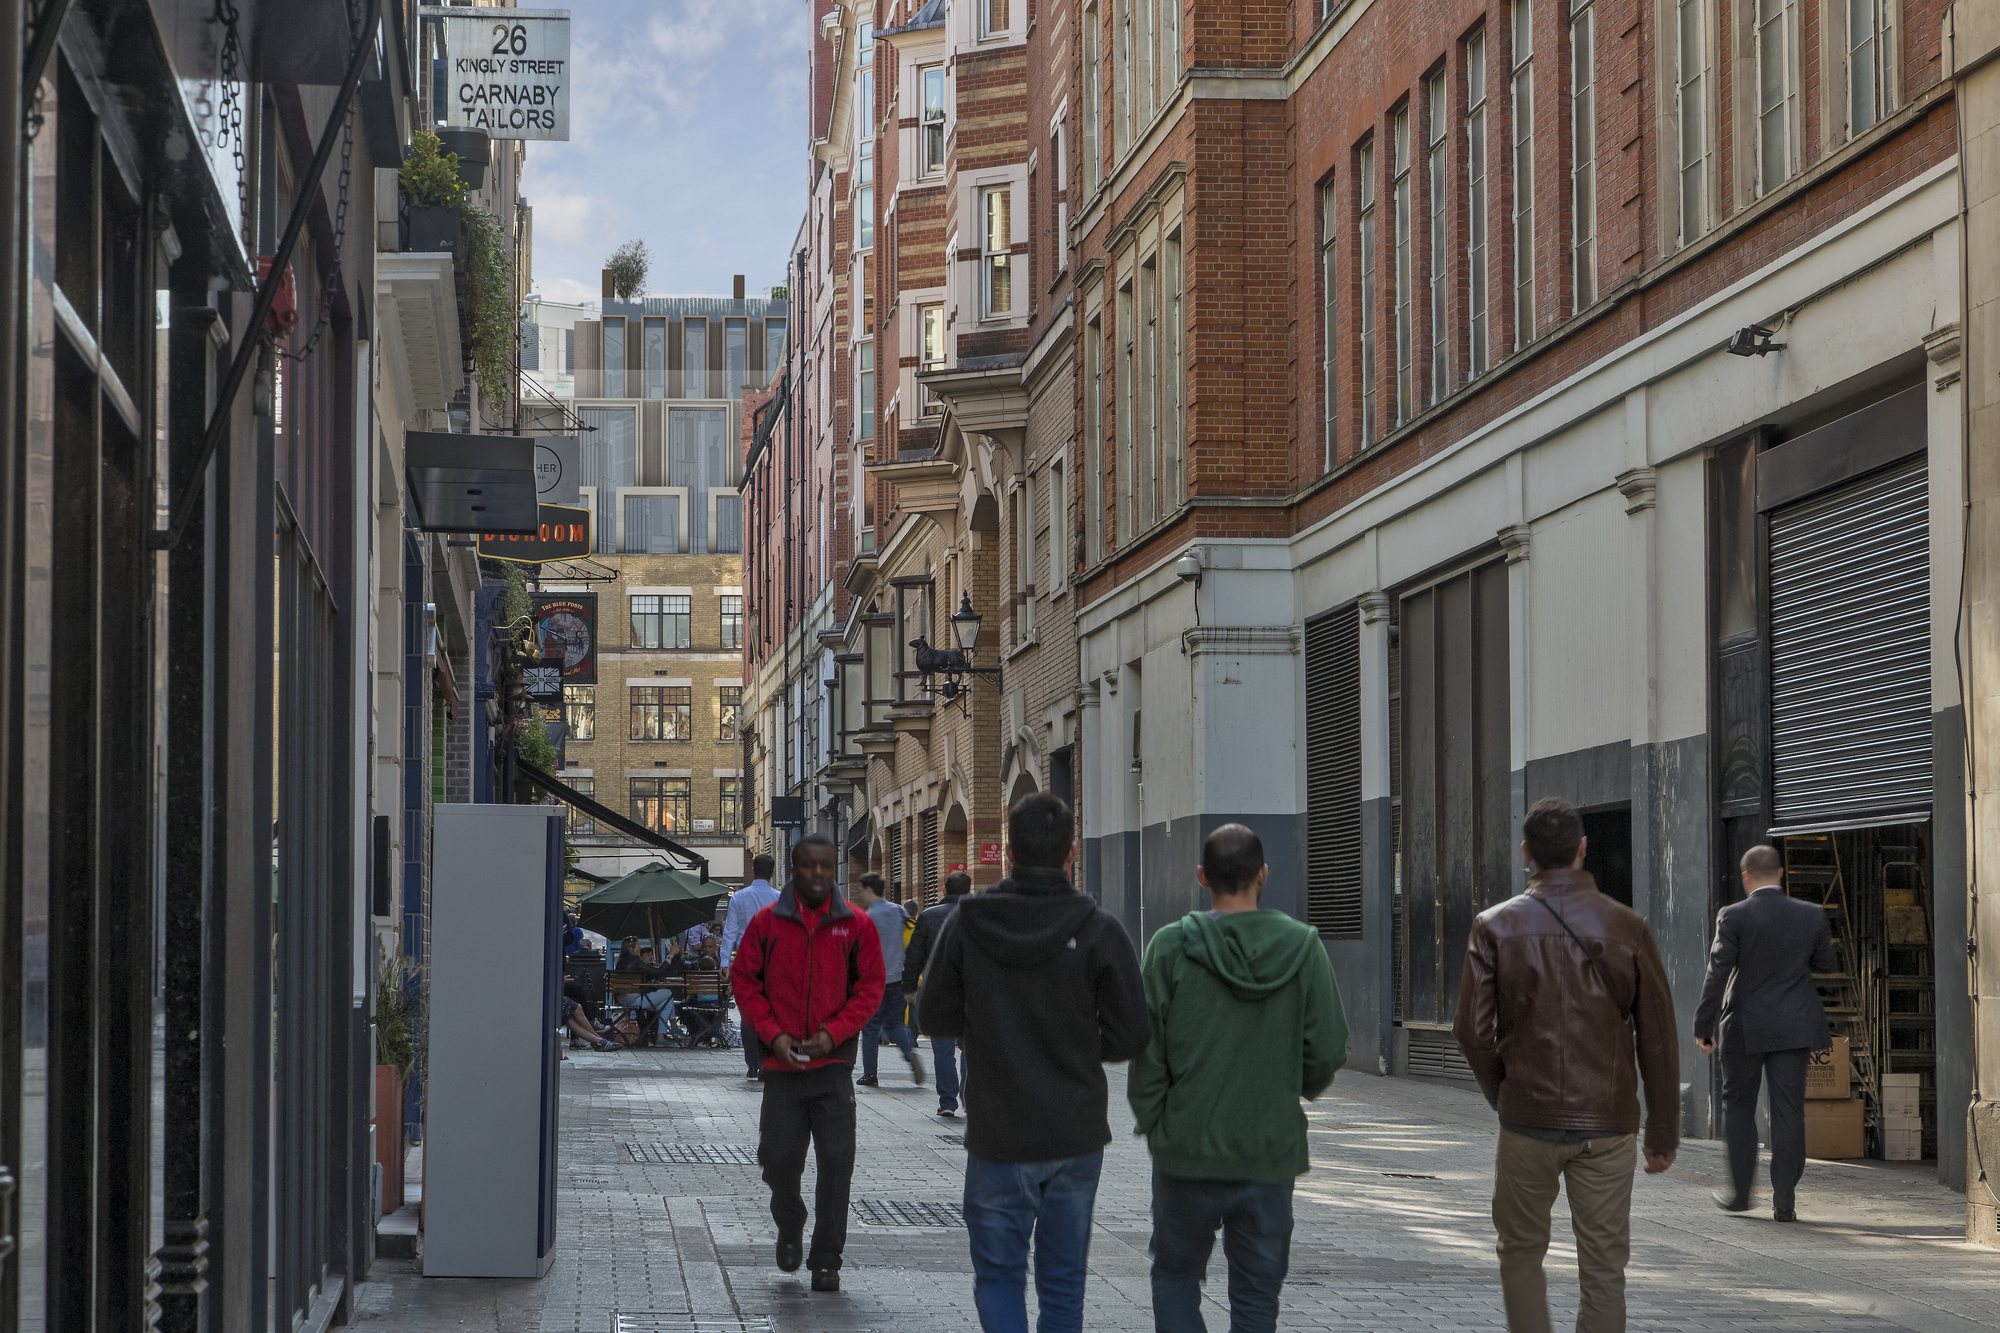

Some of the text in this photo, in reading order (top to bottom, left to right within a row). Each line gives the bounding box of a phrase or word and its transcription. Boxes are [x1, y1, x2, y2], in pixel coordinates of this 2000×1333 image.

[492, 24, 527, 56] 26
[456, 58, 565, 74] KINGLY STREET
[459, 83, 560, 106] CARNABY
[462, 107, 555, 129] TAILORS
[567, 602, 583, 610] POSTS
